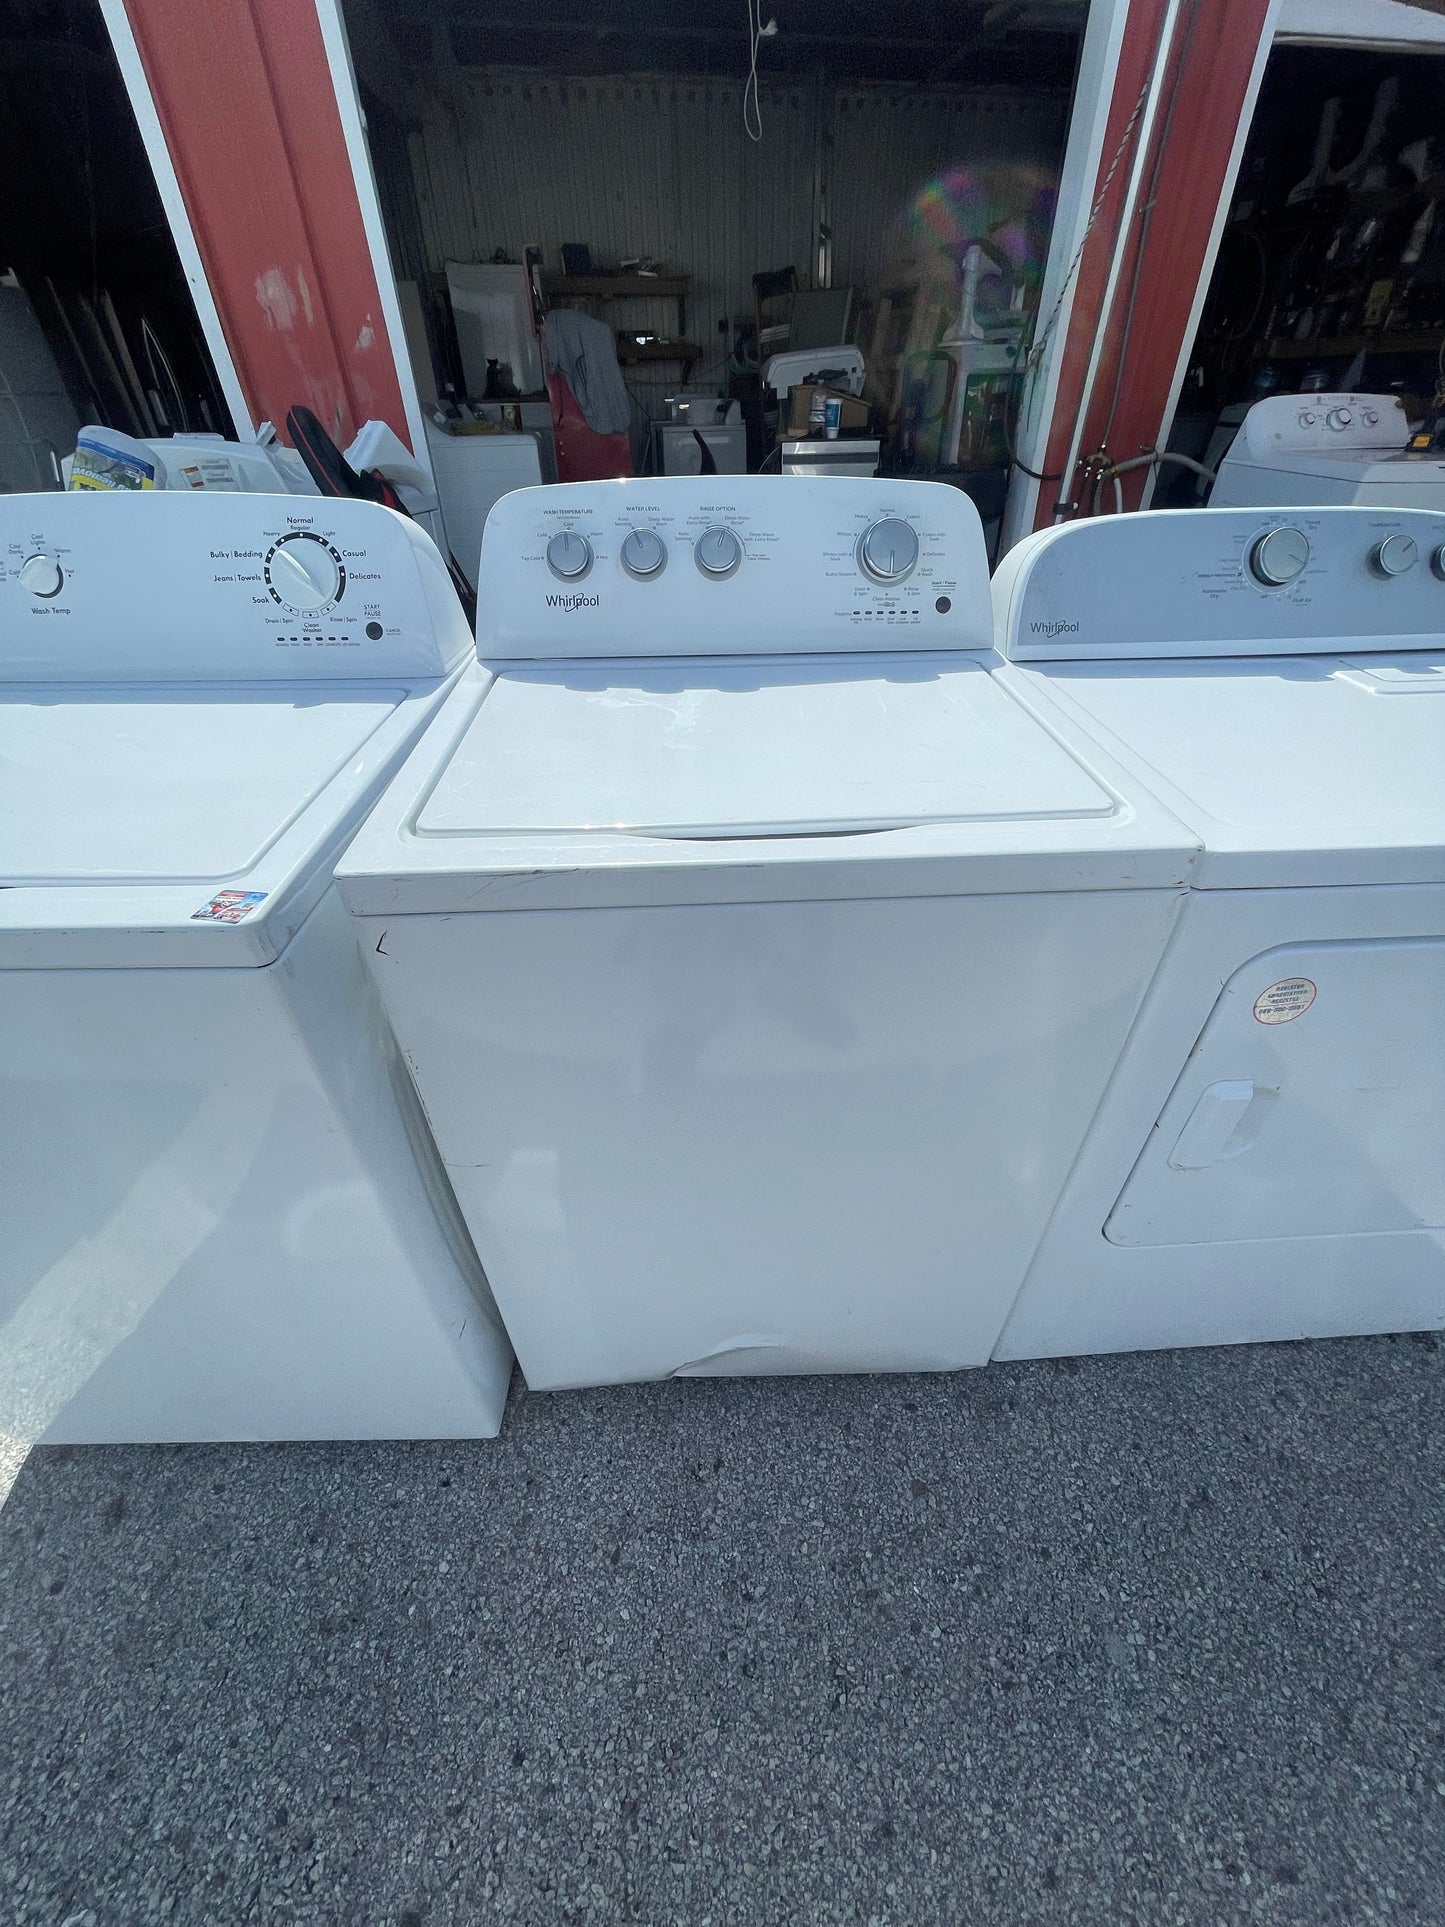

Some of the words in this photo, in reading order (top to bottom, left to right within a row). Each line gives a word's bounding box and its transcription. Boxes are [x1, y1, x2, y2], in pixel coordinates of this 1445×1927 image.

[234, 550, 262, 558] Bedding
[546, 592, 600, 612] Whirlpool
[1031, 620, 1079, 638] Whirlpool
